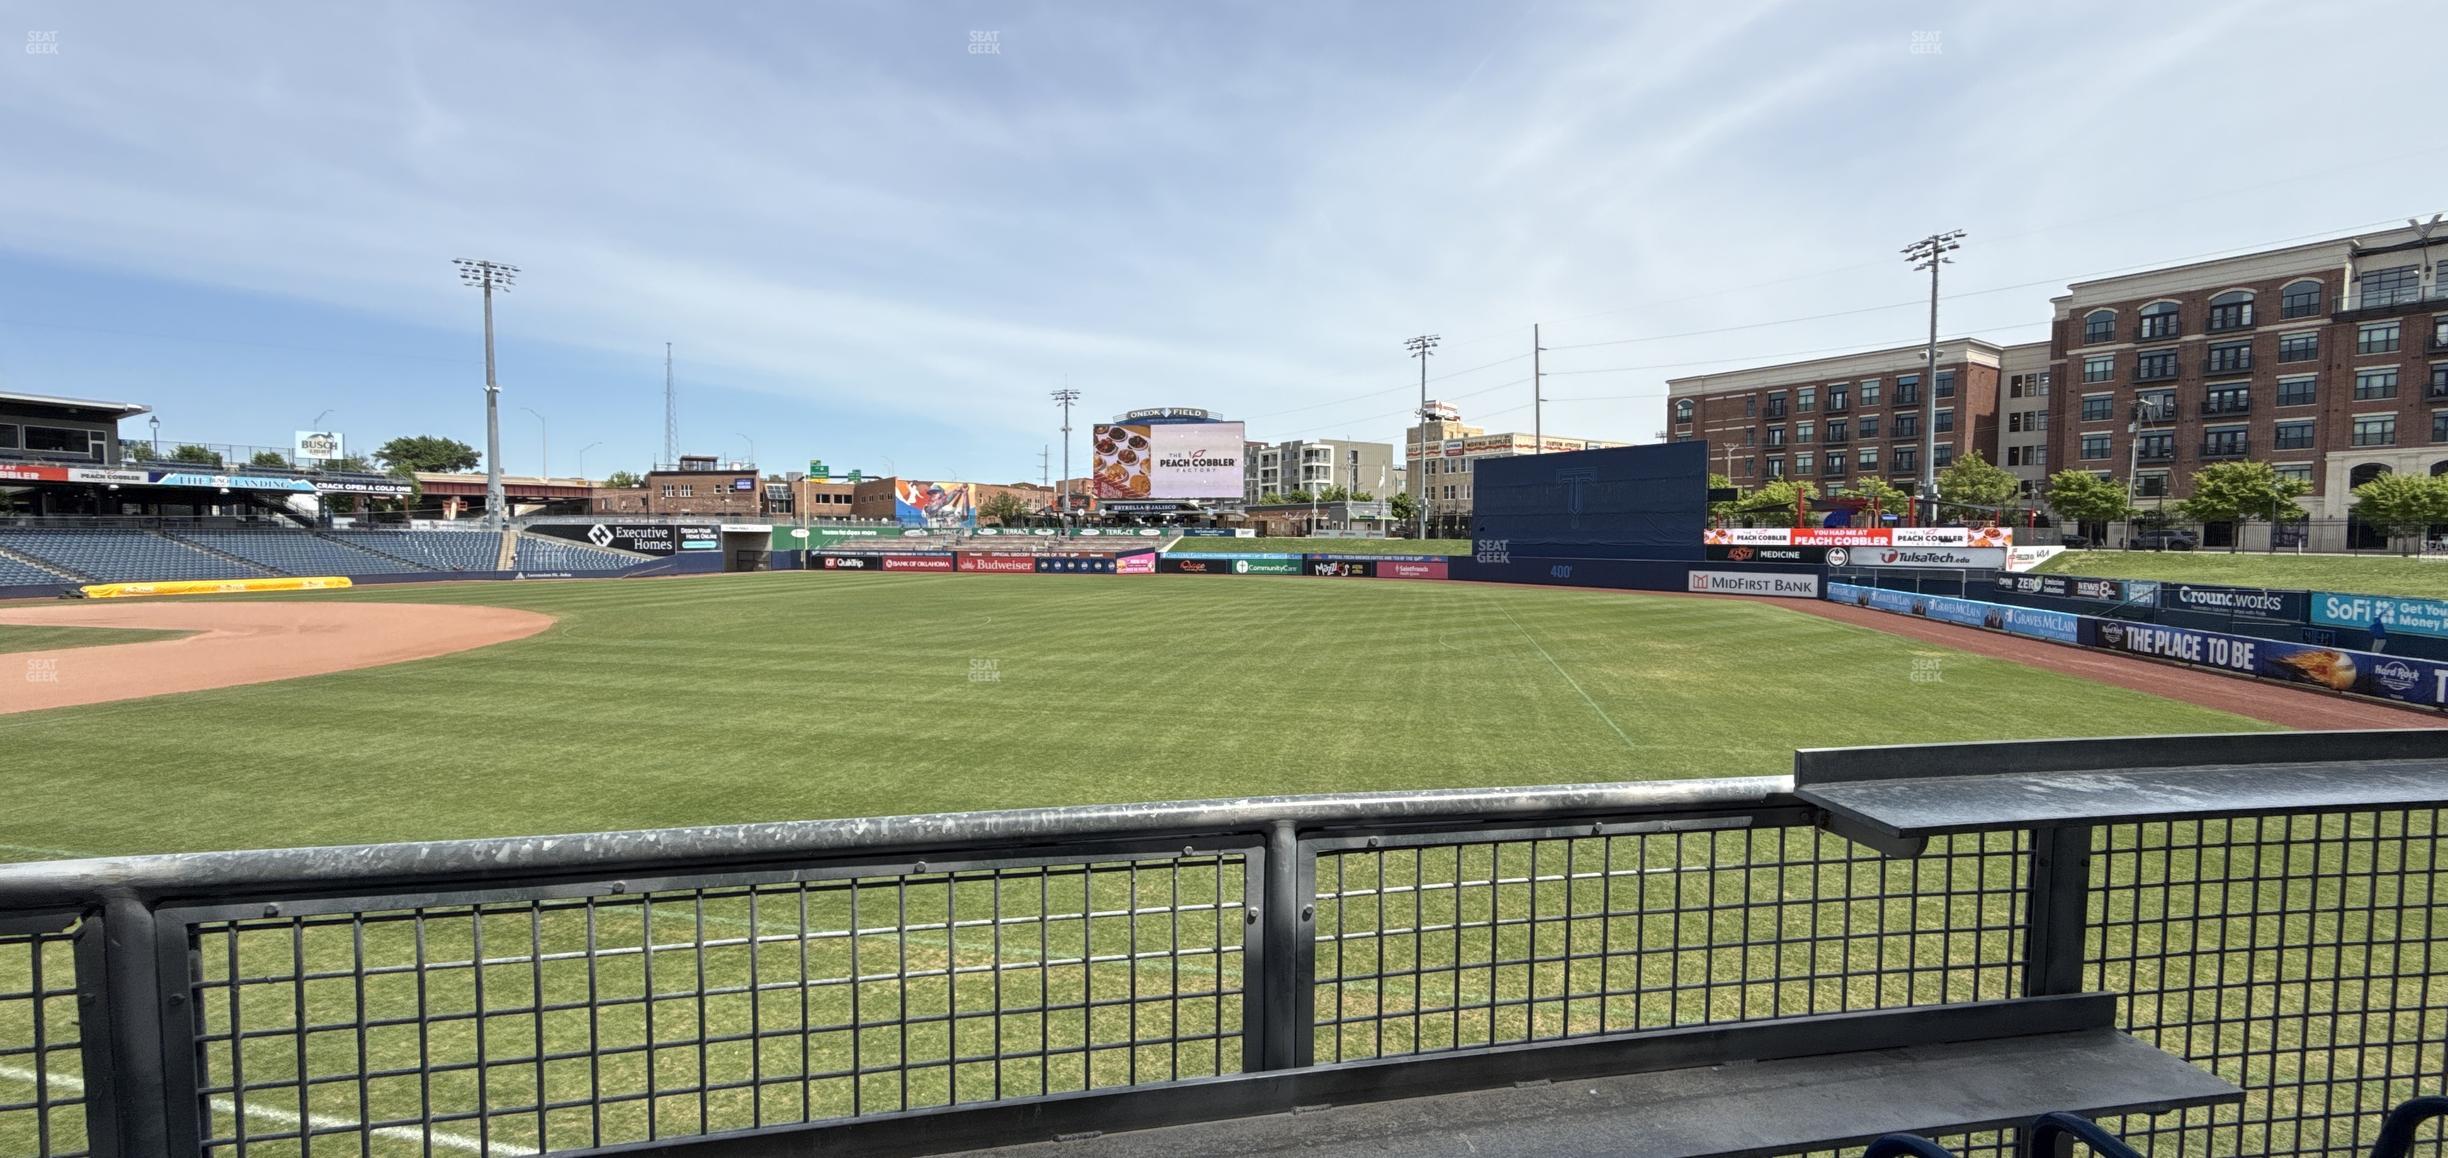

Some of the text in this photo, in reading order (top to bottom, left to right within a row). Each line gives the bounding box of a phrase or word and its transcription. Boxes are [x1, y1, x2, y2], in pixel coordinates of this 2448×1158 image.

[1130, 410, 1161, 418] ONEOK
[302, 440, 338, 450] BUSCH
[1160, 458, 1235, 467] PEACH COBBLER
[180, 476, 204, 485] THE
[235, 478, 289, 488] LANDING
[316, 482, 344, 490] CRACK
[616, 526, 668, 538] Executive
[634, 539, 672, 550] Homes
[1795, 536, 1889, 546] PEACH COBBLER
[1899, 552, 1970, 563] TulsaTech.edu
[2036, 550, 2050, 558] KIA
[837, 559, 864, 568] QuikTrip
[977, 560, 1032, 570] Budweiser
[1999, 578, 2012, 586] OMNI
[2078, 581, 2109, 597] NEWS 8
[2326, 597, 2371, 622] SoFi
[2400, 602, 2422, 614] Get
[2014, 610, 2042, 628] GRAVES
[2400, 614, 2440, 631] Money
[2126, 626, 2254, 670] THE PLACE TO BE
[2375, 664, 2419, 681] Hard Rock
